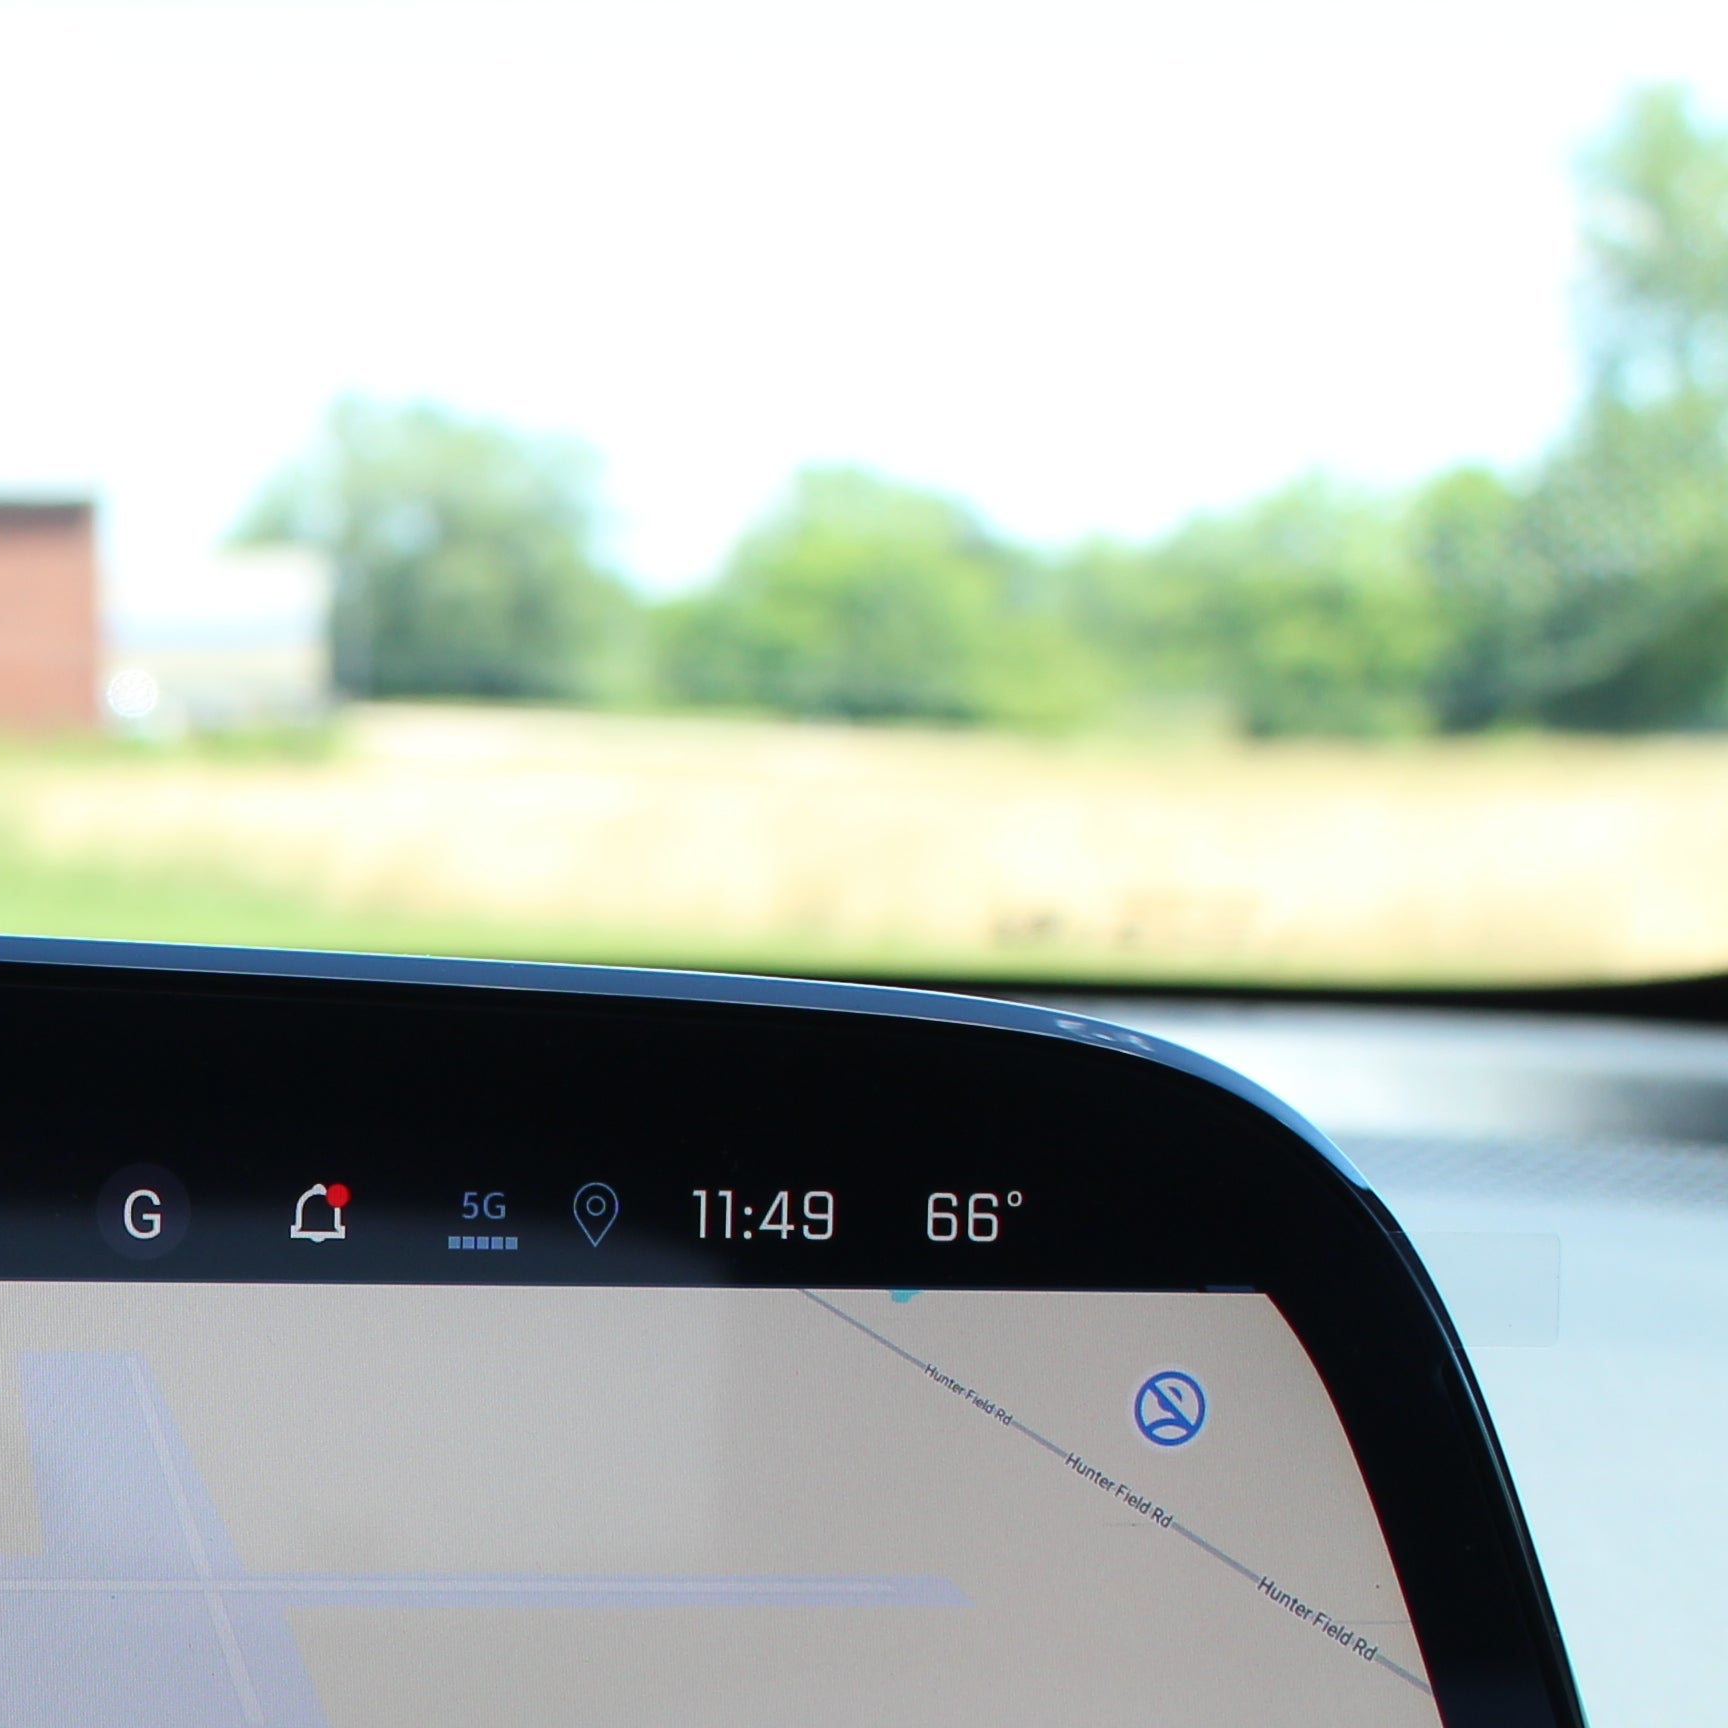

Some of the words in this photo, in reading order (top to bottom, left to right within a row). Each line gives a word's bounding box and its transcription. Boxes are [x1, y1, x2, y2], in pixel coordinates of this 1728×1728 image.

[123, 1190, 162, 1238] G
[462, 1193, 506, 1219] 5G
[693, 1191, 835, 1240] 11:49
[925, 1364, 965, 1397] Hunter
[966, 1389, 996, 1413] Field
[995, 1408, 1013, 1426] Rd
[1065, 1453, 1114, 1495] Hunter
[1114, 1484, 1152, 1516] Field
[1149, 1506, 1172, 1528] Rd
[1258, 1577, 1312, 1622] Hunter
[1312, 1612, 1354, 1647] Field
[1352, 1636, 1377, 1661] Rd
